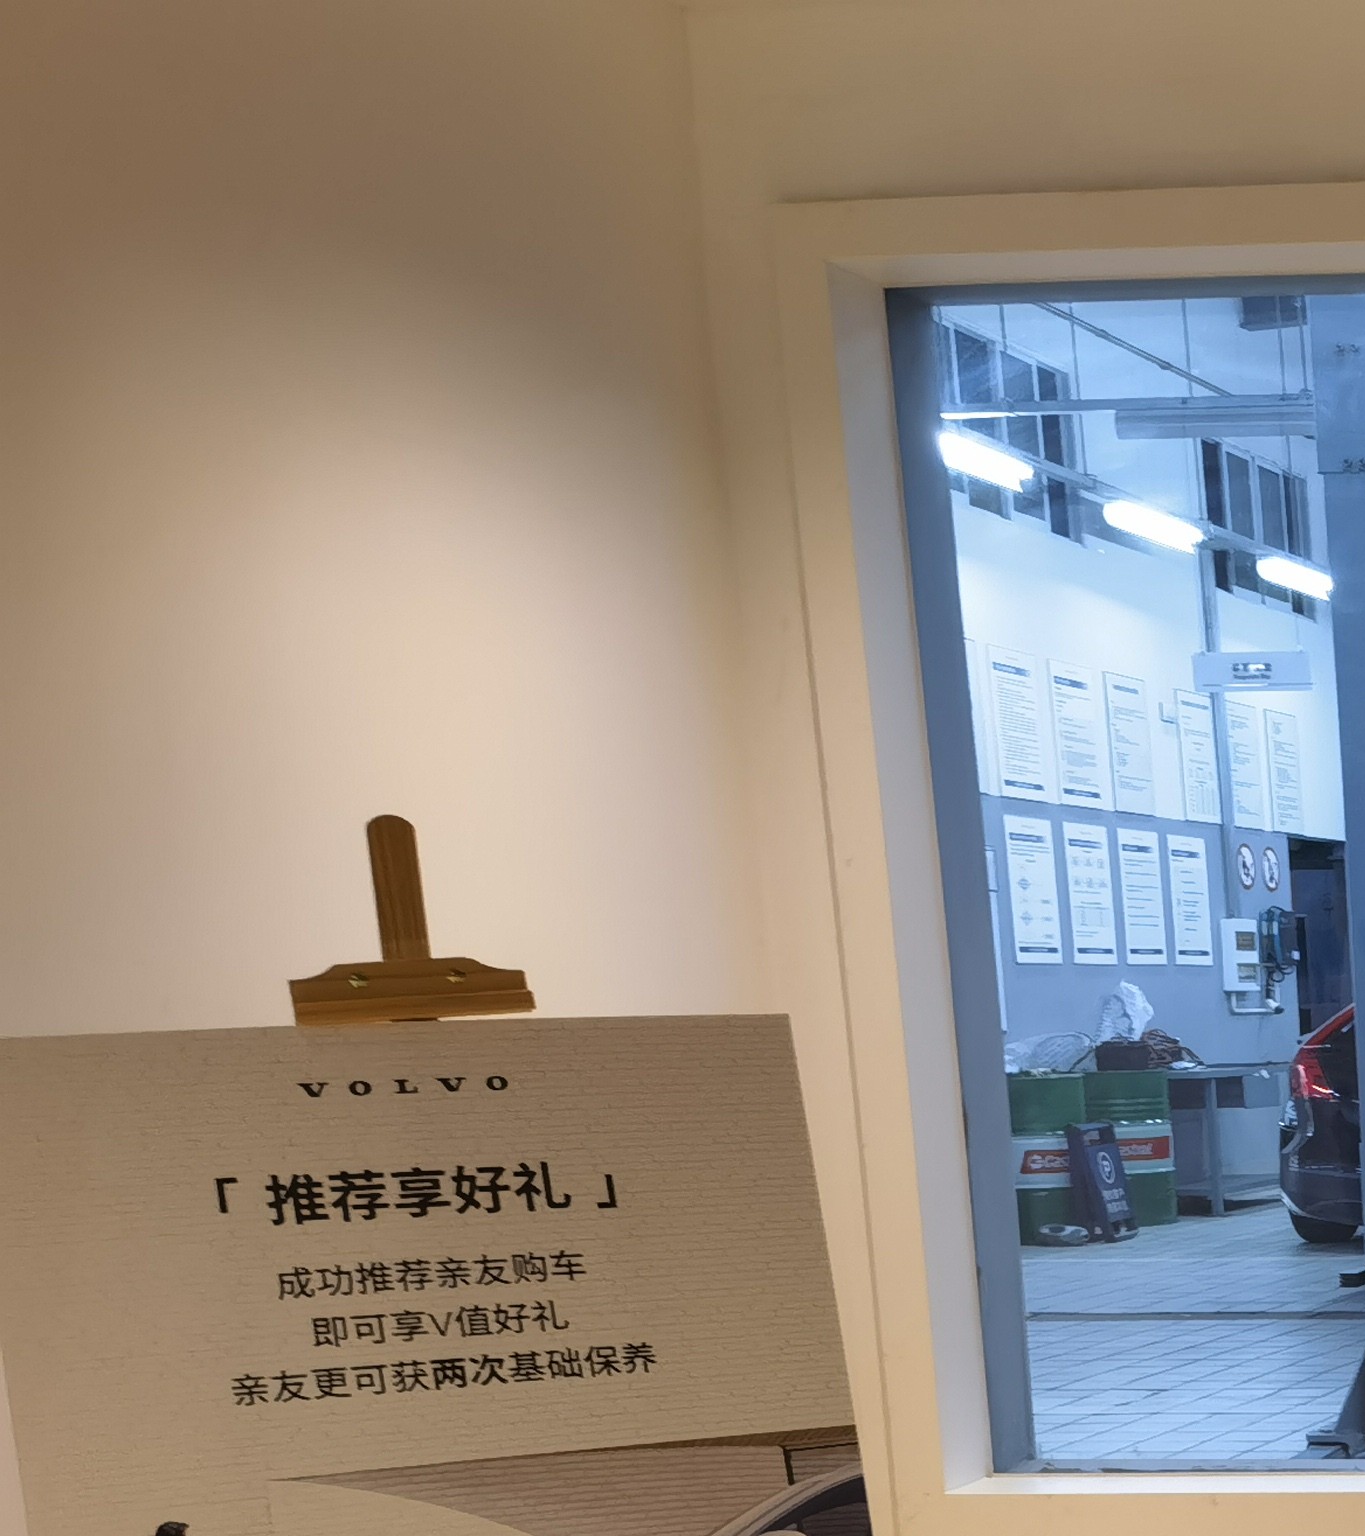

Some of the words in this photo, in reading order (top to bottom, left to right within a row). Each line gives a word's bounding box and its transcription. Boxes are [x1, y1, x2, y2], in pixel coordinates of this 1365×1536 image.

[296, 1075, 509, 1098] VOLVO
[277, 1250, 588, 1300] 成功推荐亲友购车
[311, 1299, 570, 1348] 即可享V值好礼
[230, 1342, 657, 1406] 亲友更可获两次基础保养
